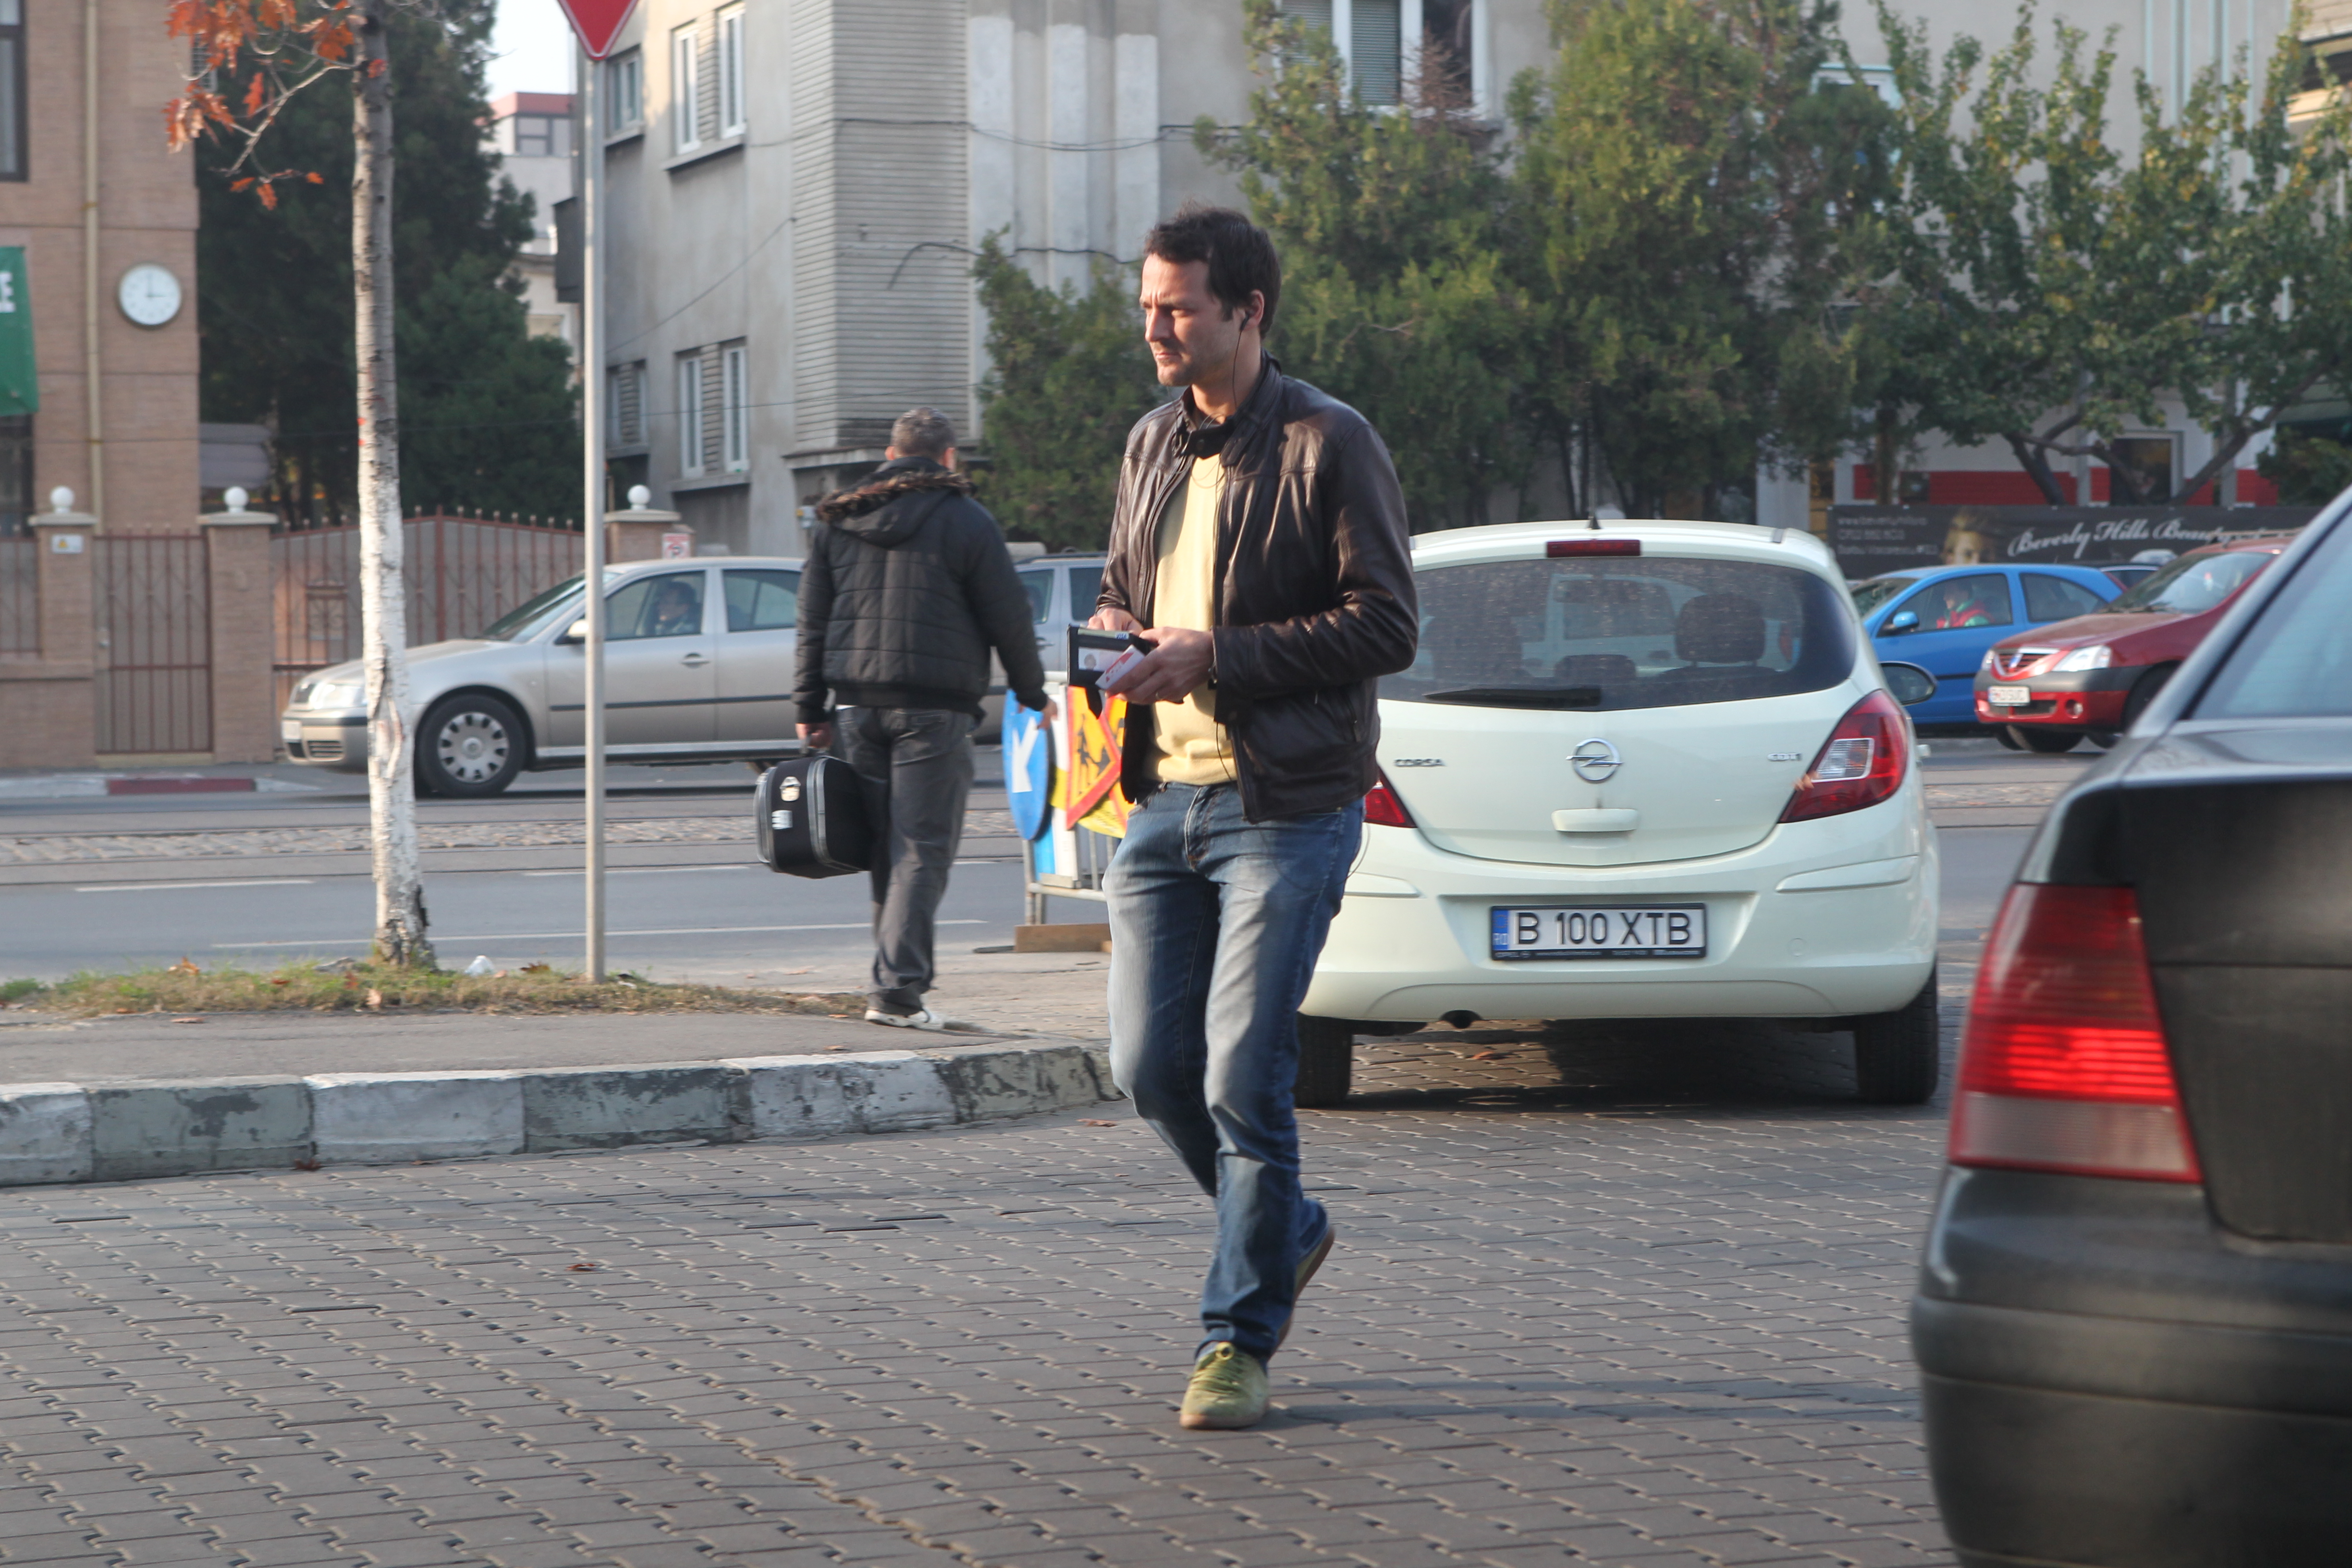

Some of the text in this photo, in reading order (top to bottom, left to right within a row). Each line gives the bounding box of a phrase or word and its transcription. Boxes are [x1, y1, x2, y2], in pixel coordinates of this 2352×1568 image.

[2008, 522, 2090, 559] Beverly
[2093, 518, 2149, 541] Hills
[1394, 759, 1445, 768] CORSA
[1515, 912, 1690, 945] B 100 XTB
